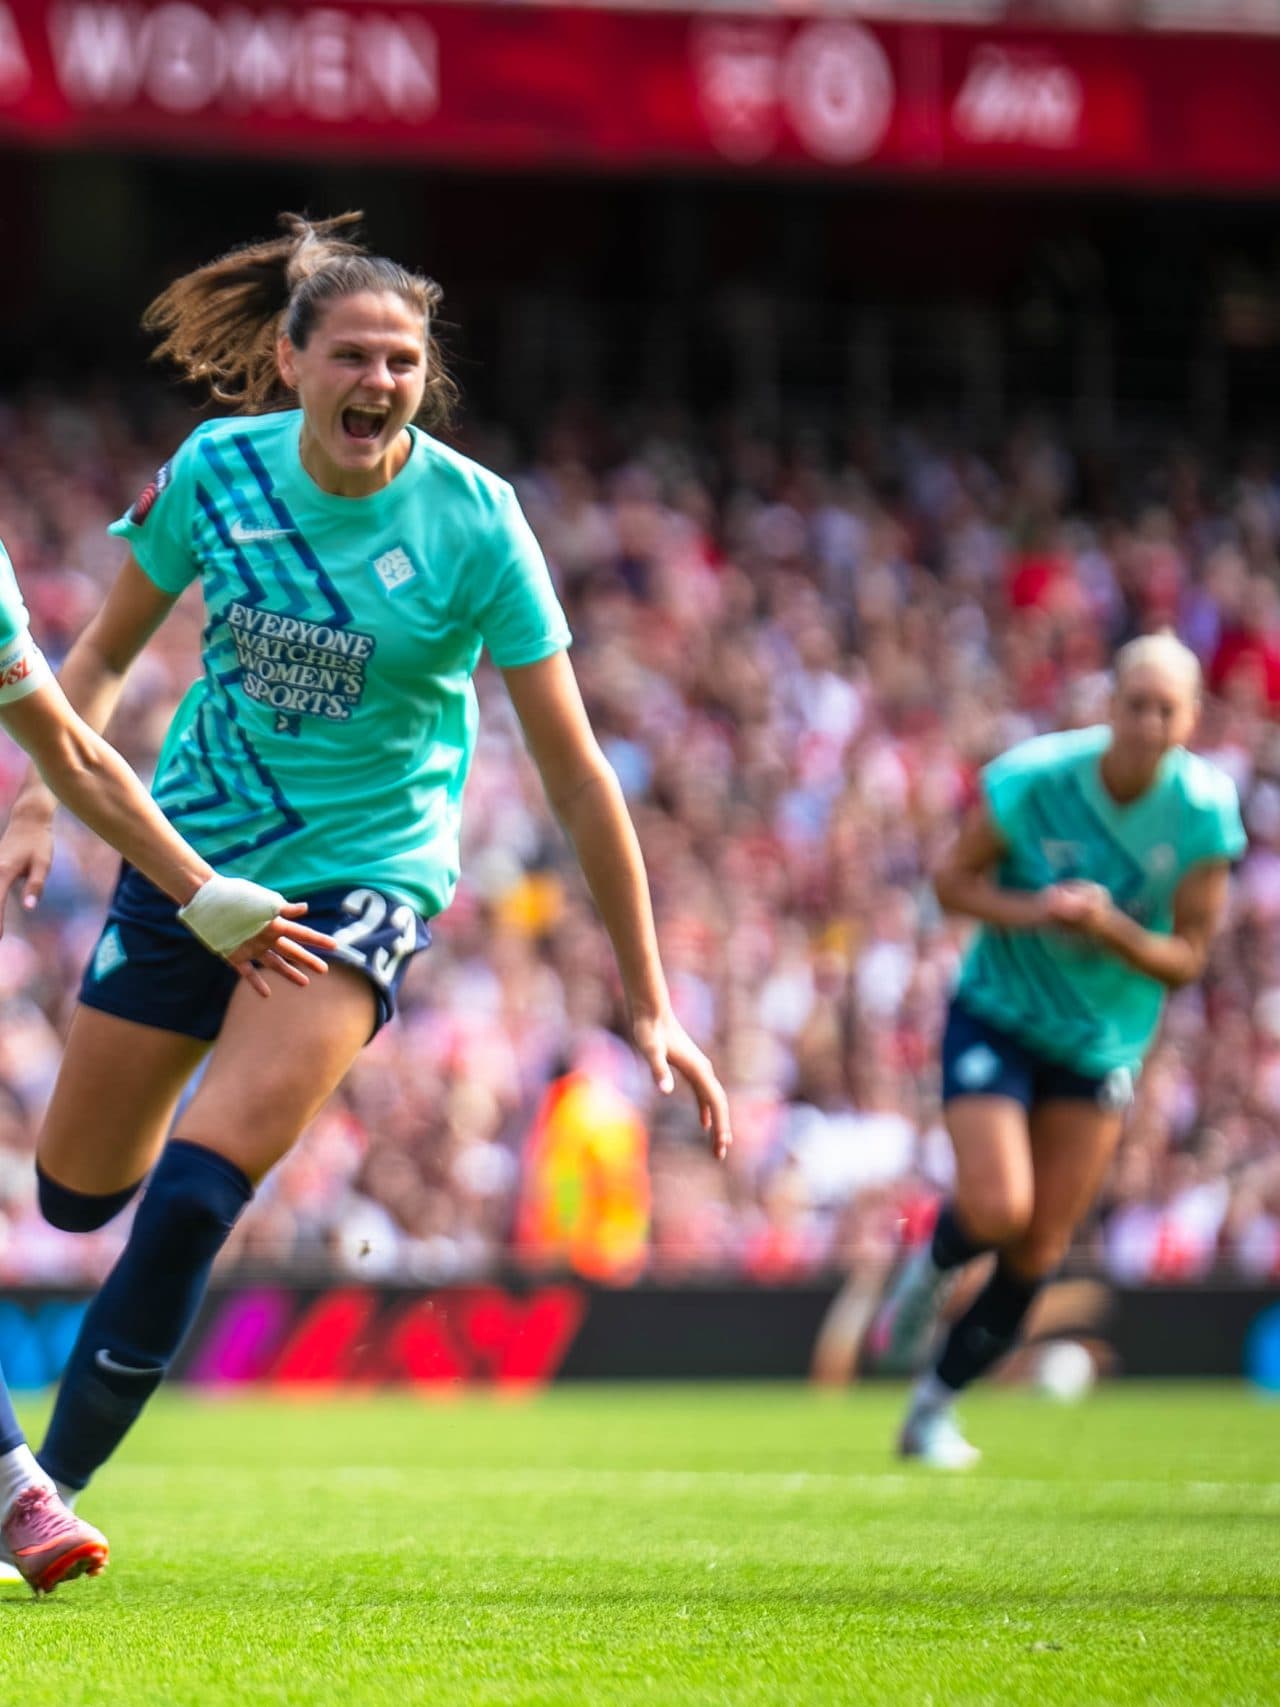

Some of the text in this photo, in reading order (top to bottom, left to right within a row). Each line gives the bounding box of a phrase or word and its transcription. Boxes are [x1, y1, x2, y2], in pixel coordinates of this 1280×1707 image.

[46, 2, 440, 122] WOMEN
[227, 602, 374, 659] EVERYONE
[232, 627, 363, 673] WATCHES
[238, 645, 363, 695] WOMEN'S
[243, 673, 350, 719] SPORTS.
